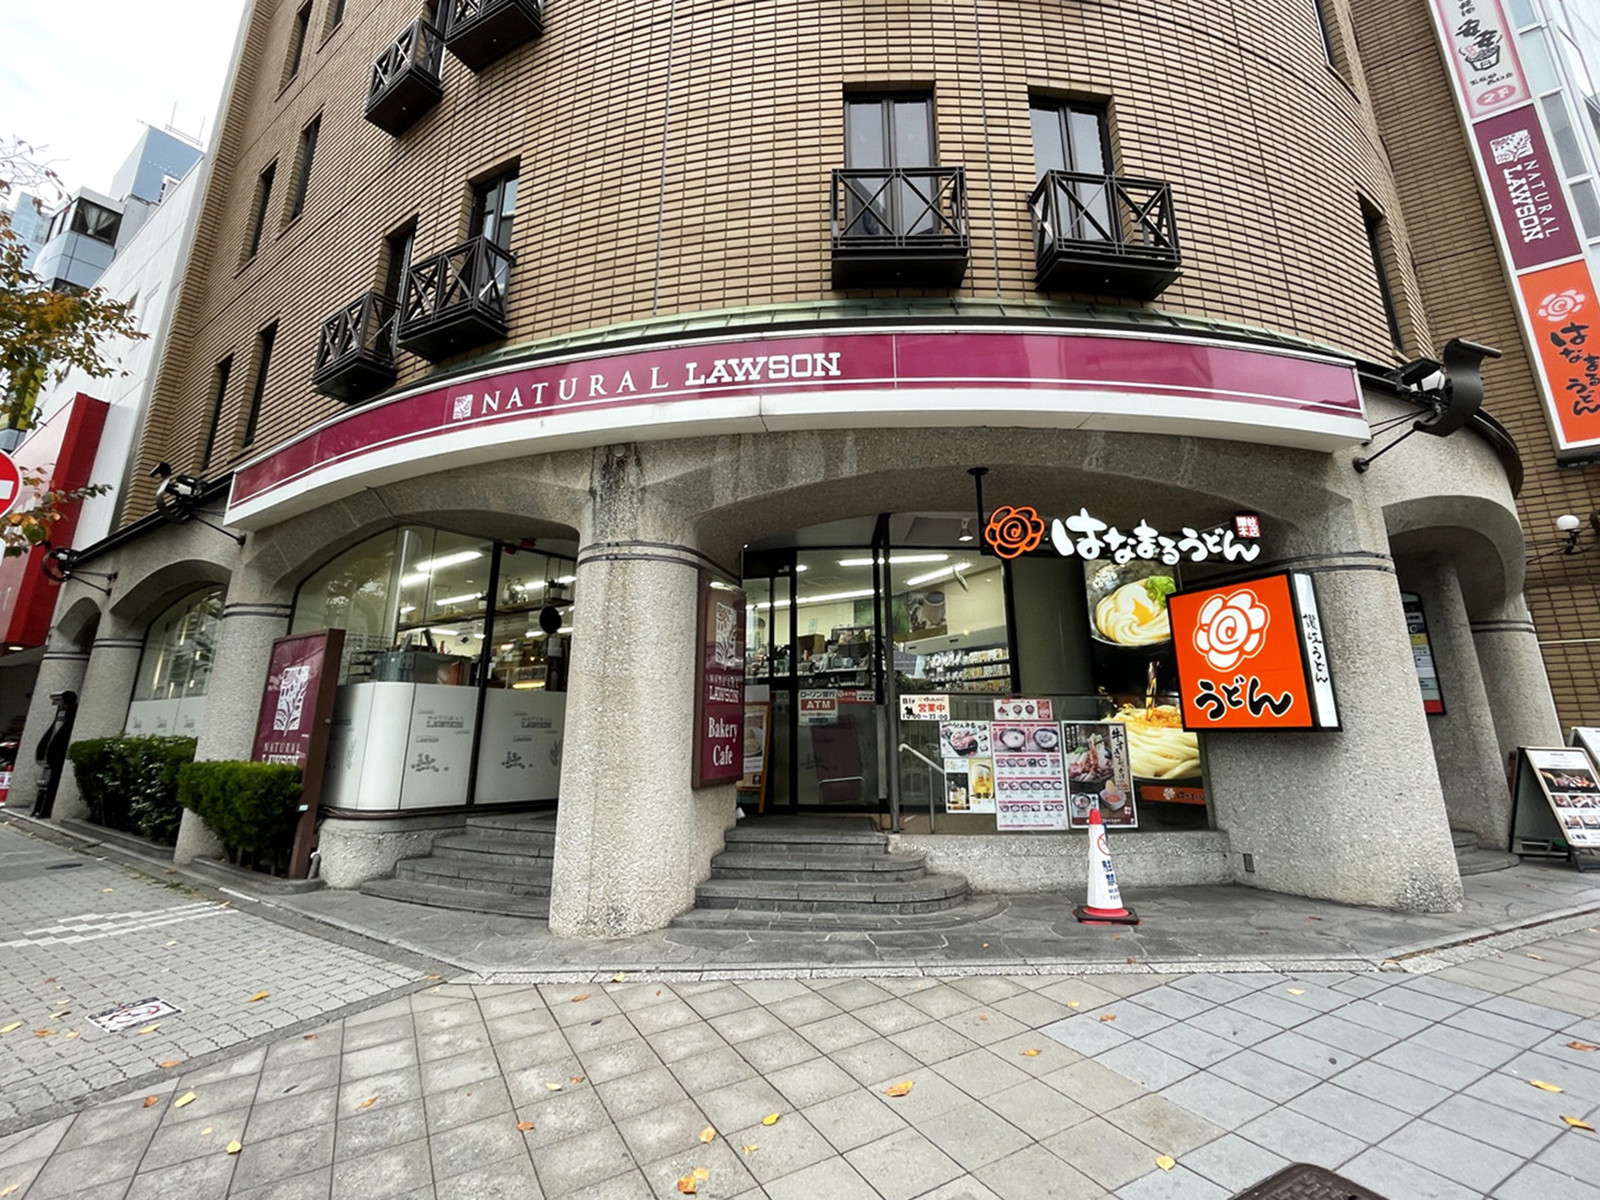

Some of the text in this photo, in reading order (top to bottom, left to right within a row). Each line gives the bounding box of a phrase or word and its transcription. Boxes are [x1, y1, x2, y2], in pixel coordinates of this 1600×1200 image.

[1483, 87, 1509, 103] 2F
[1503, 164, 1544, 243] LAWSON
[1523, 159, 1560, 237] NATURAL
[481, 352, 842, 414] NATURAL LAWSON
[1051, 507, 1261, 565] はなまるうどん
[709, 685, 740, 703] LAWSON
[806, 700, 832, 709] ATM
[1194, 676, 1294, 721] うどん
[917, 703, 946, 713] 営業中
[708, 717, 738, 743] Bakery
[264, 741, 301, 753] NATURAL
[712, 744, 734, 766] Cafe
